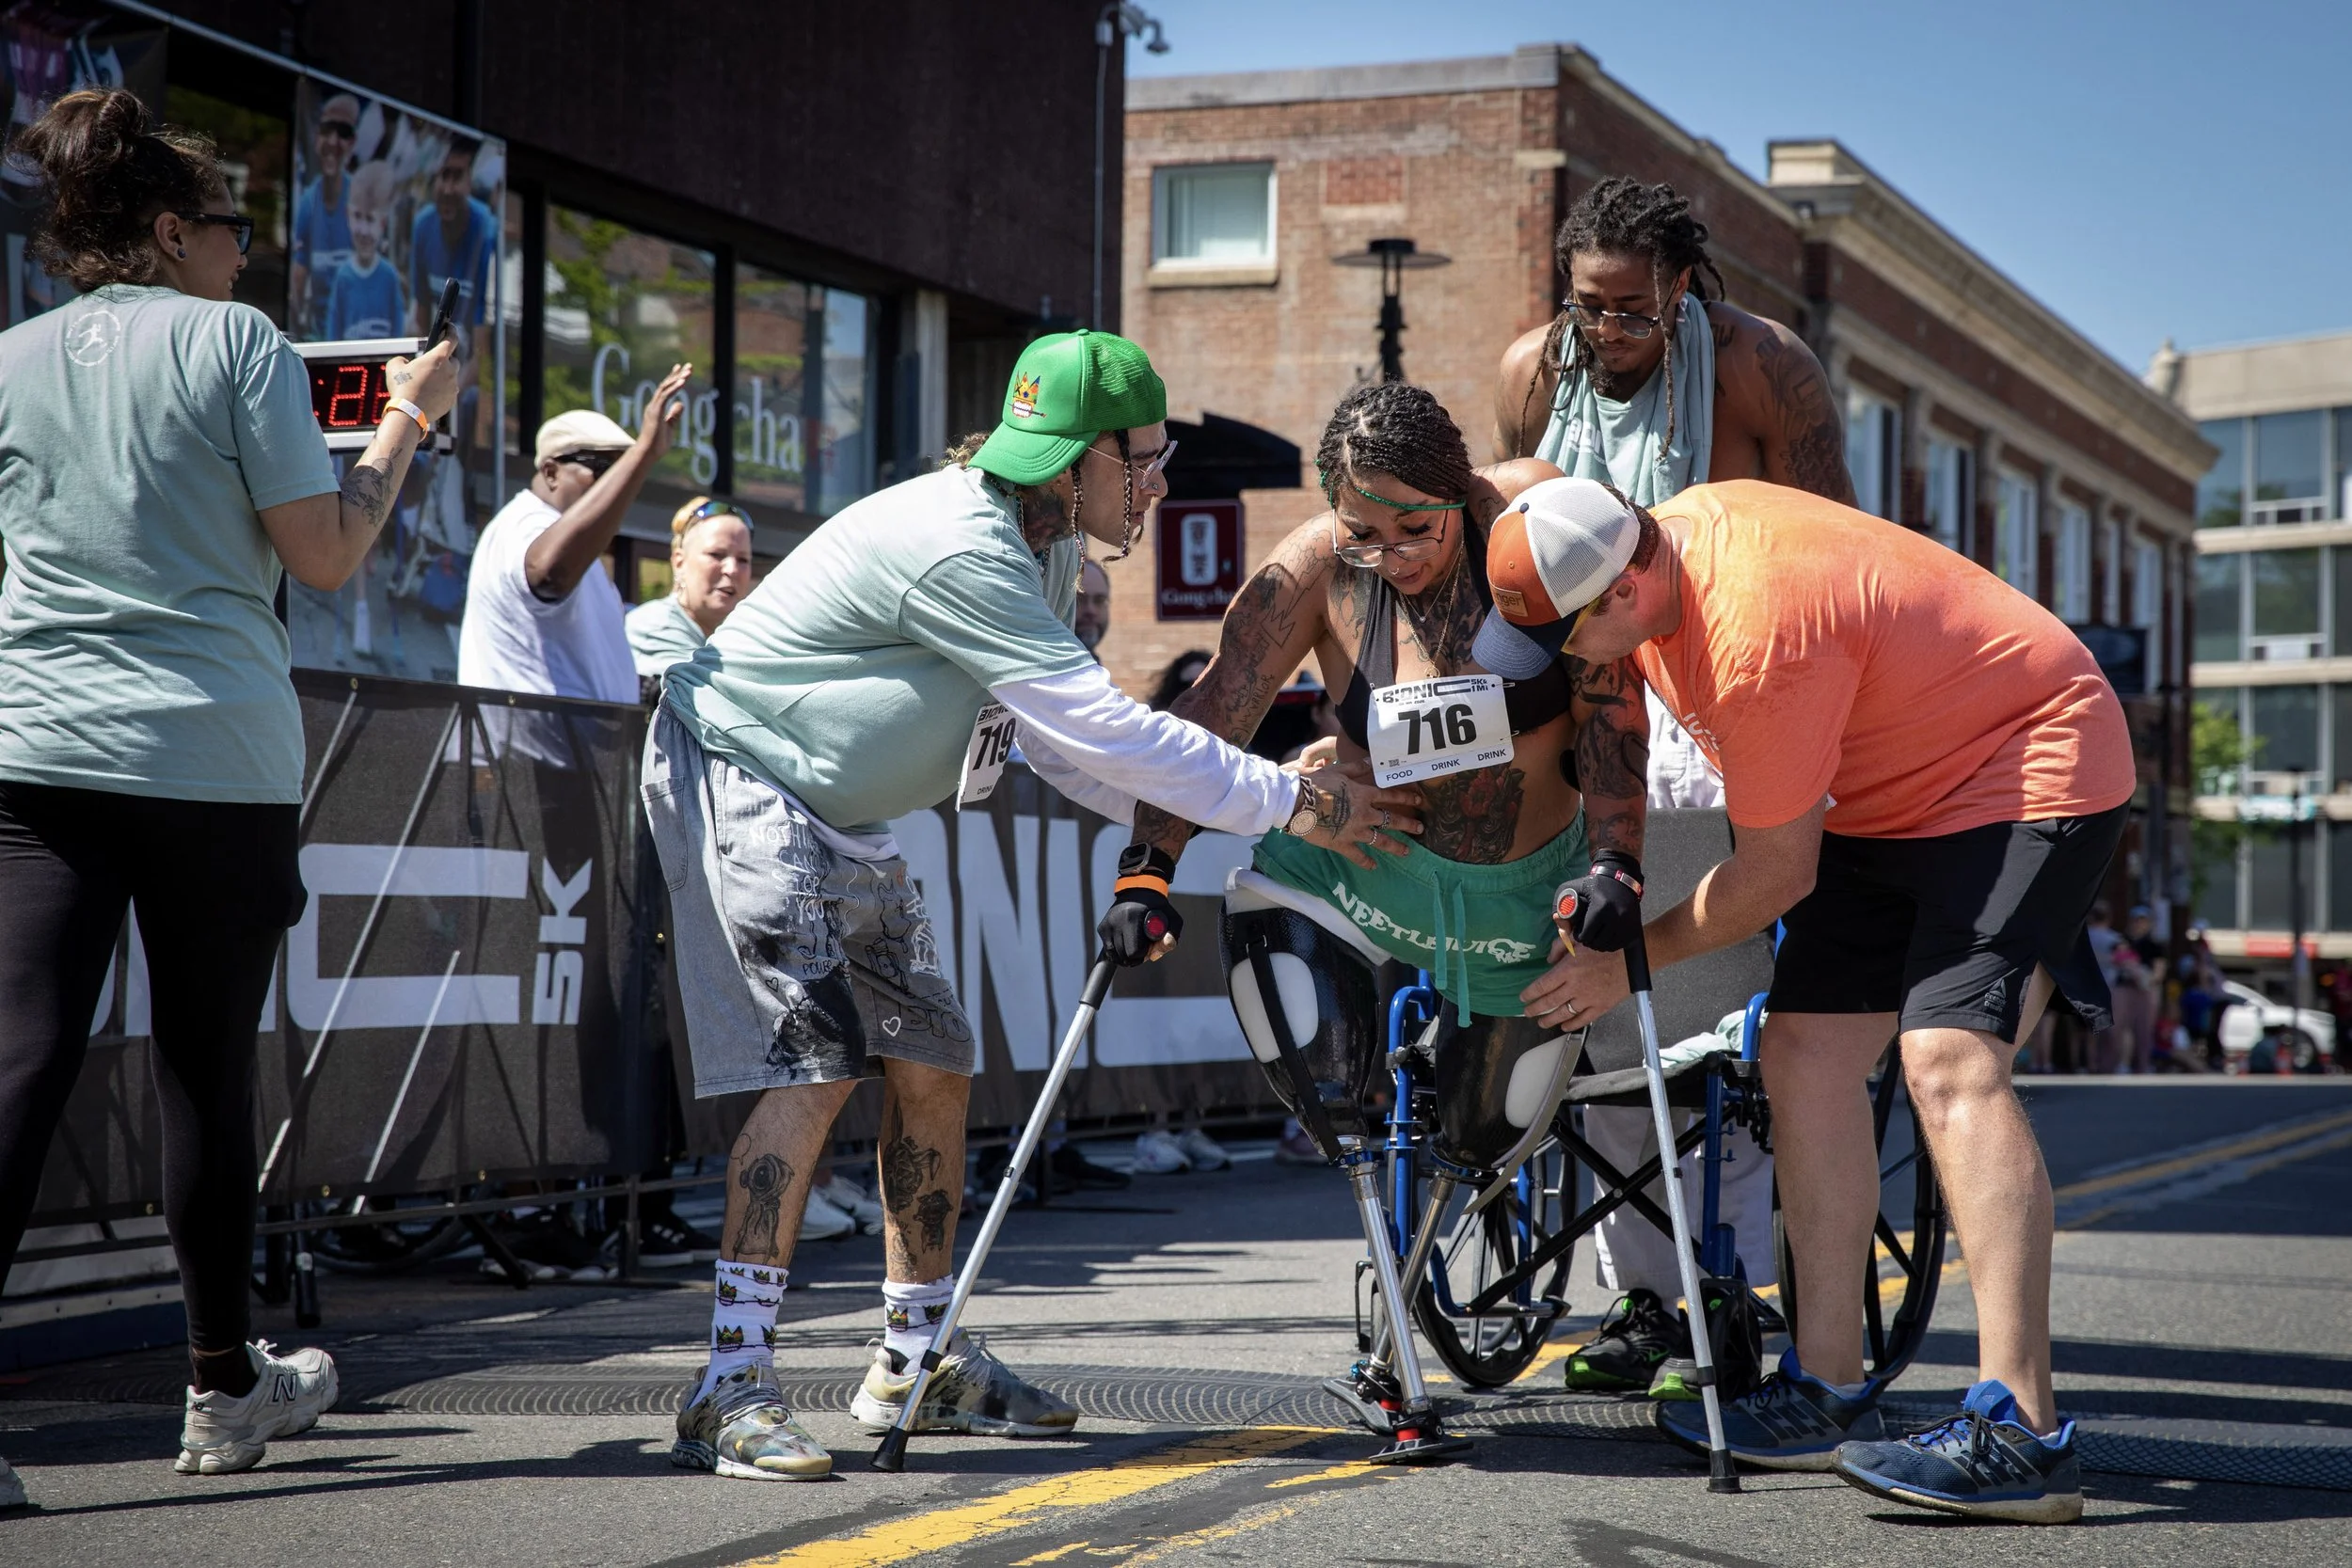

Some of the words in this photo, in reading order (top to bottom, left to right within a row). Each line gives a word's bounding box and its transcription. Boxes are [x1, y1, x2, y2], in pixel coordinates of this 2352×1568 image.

[1383, 679, 1471, 704] BIONIC
[1398, 704, 1477, 755] 716
[972, 718, 1016, 770] 719
[1477, 749, 1506, 762] DRINK
[1386, 769, 1413, 782] FOOD
[1431, 759, 1460, 771] DRINK
[778, 849, 818, 875] CAN
[771, 868, 820, 894] STOP
[796, 895, 825, 925] YOU
[532, 857, 593, 1025] 5K
[271, 1373, 297, 1403] N
